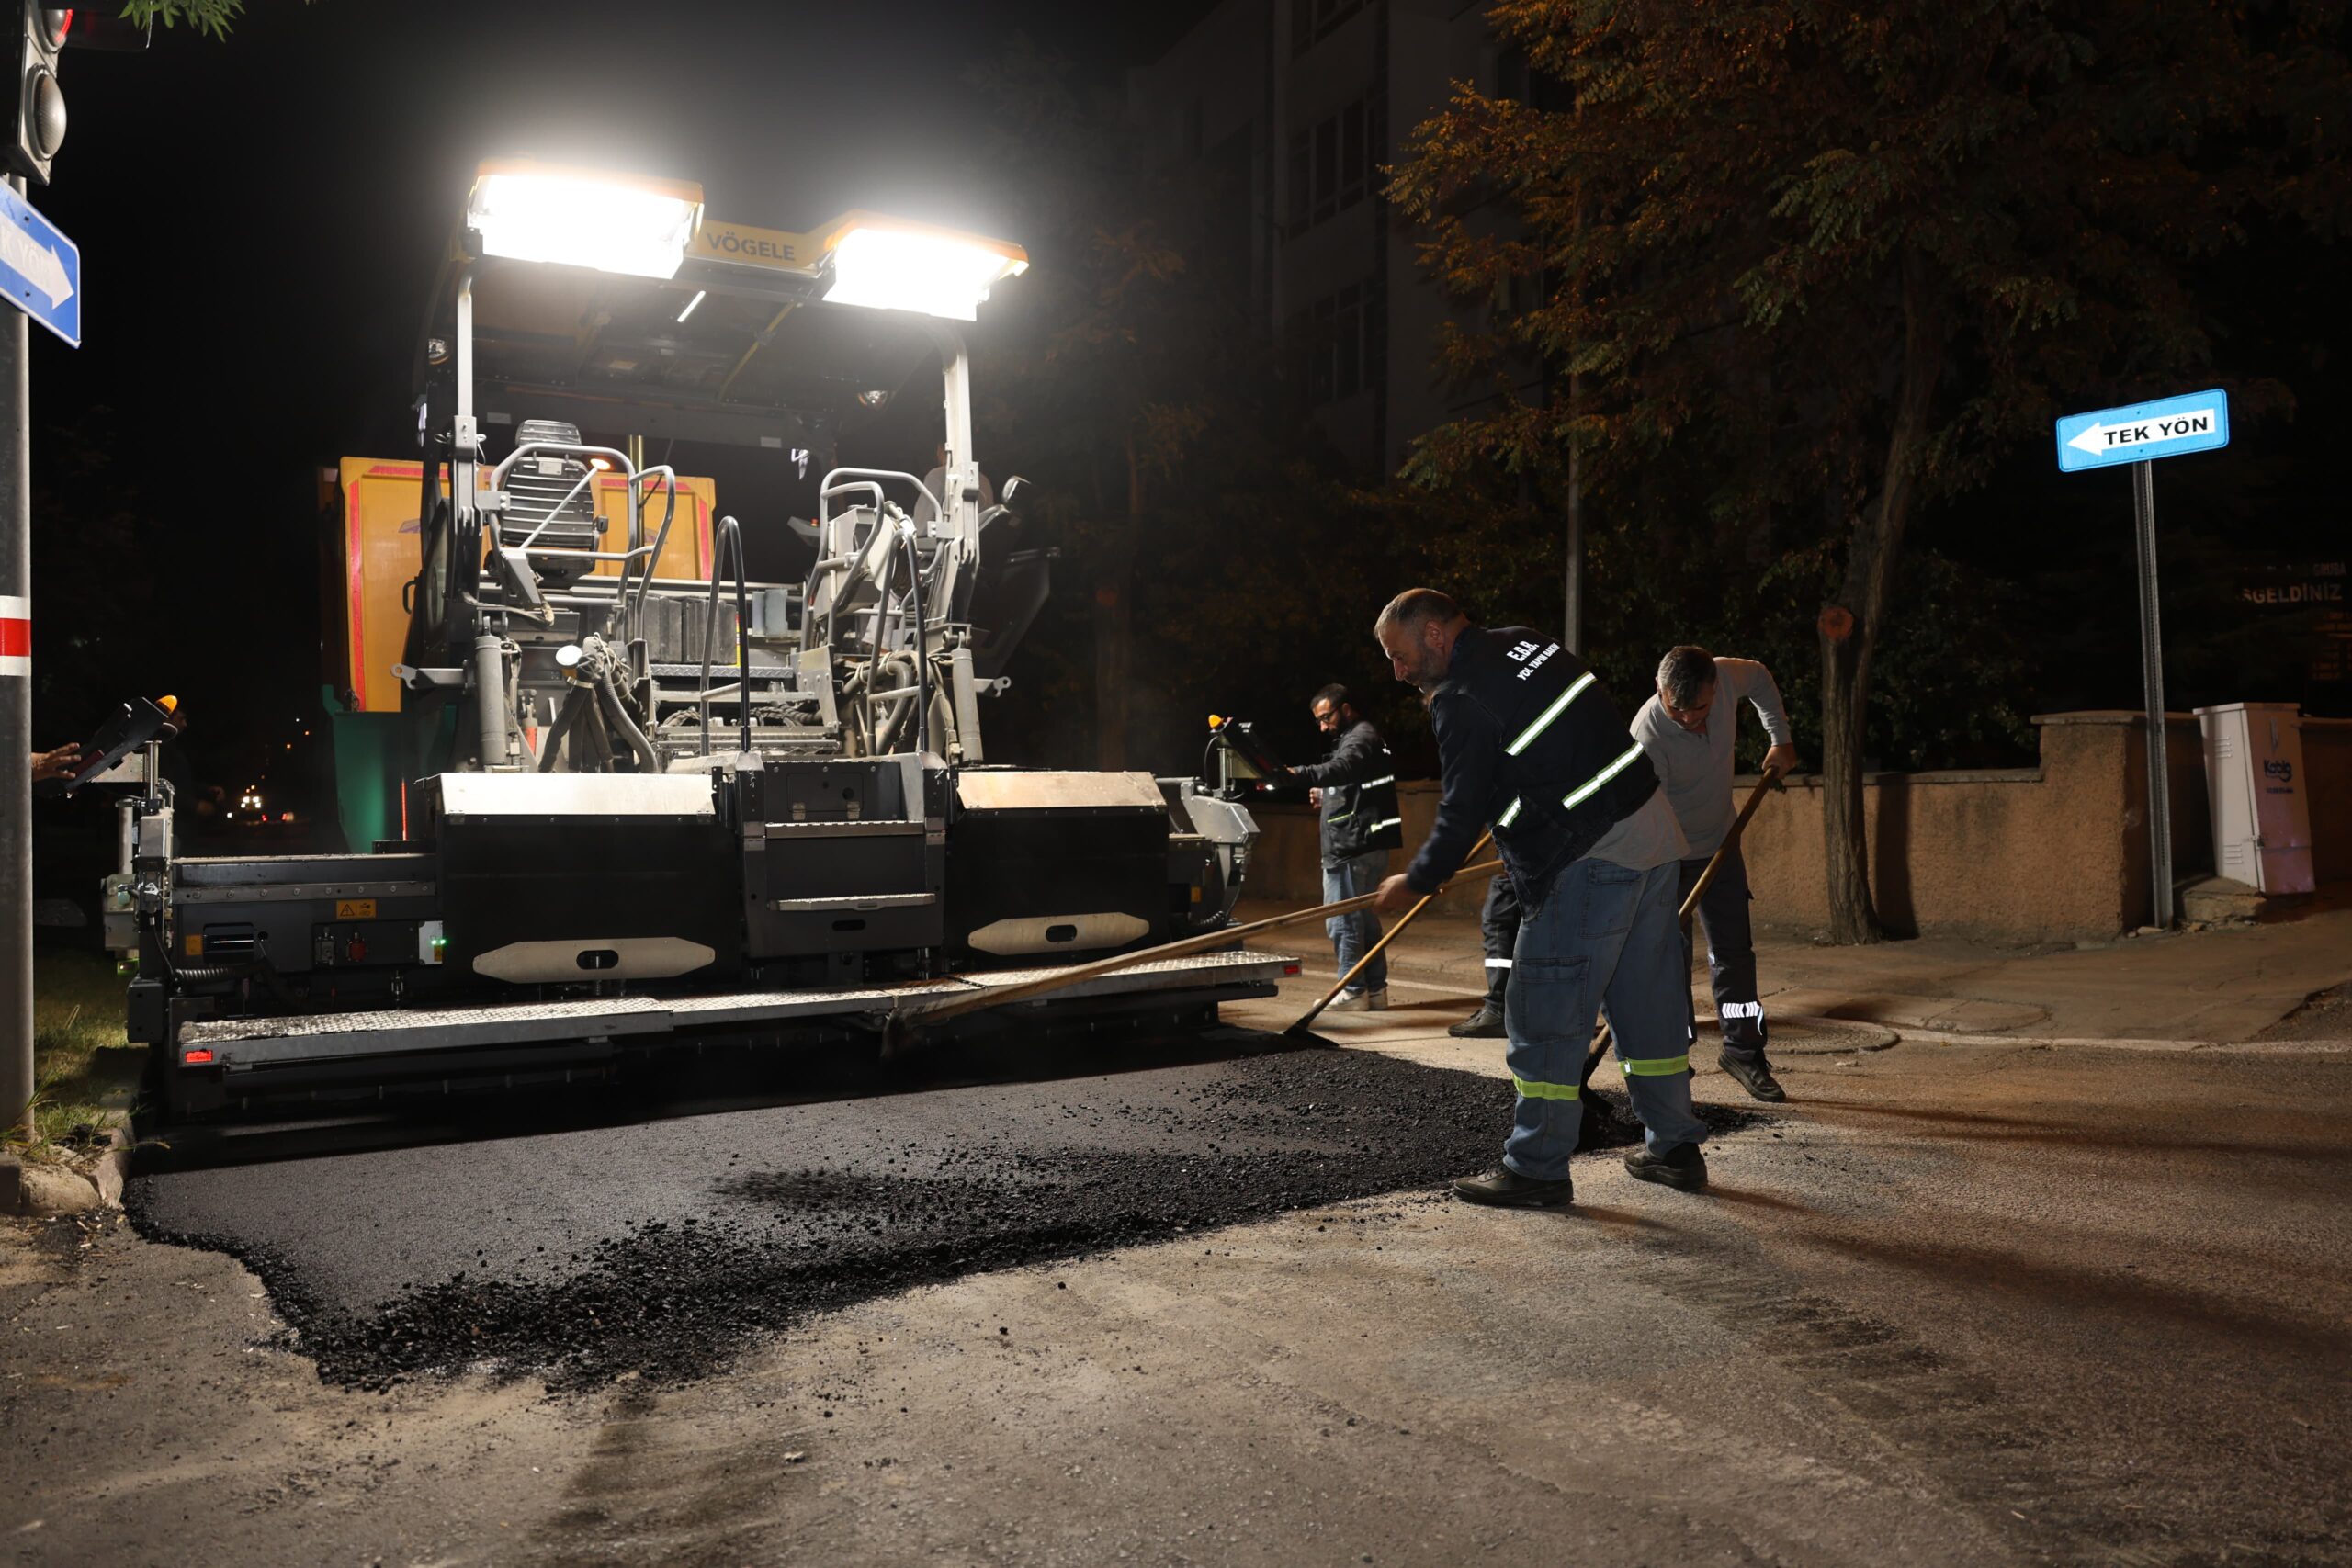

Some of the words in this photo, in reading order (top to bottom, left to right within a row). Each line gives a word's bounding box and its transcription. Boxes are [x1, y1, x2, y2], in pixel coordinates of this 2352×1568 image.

[707, 231, 796, 262] VÖGELE
[2104, 425, 2151, 446] TEK
[2159, 416, 2208, 437] YÖN
[1516, 667, 1535, 681] YOL
